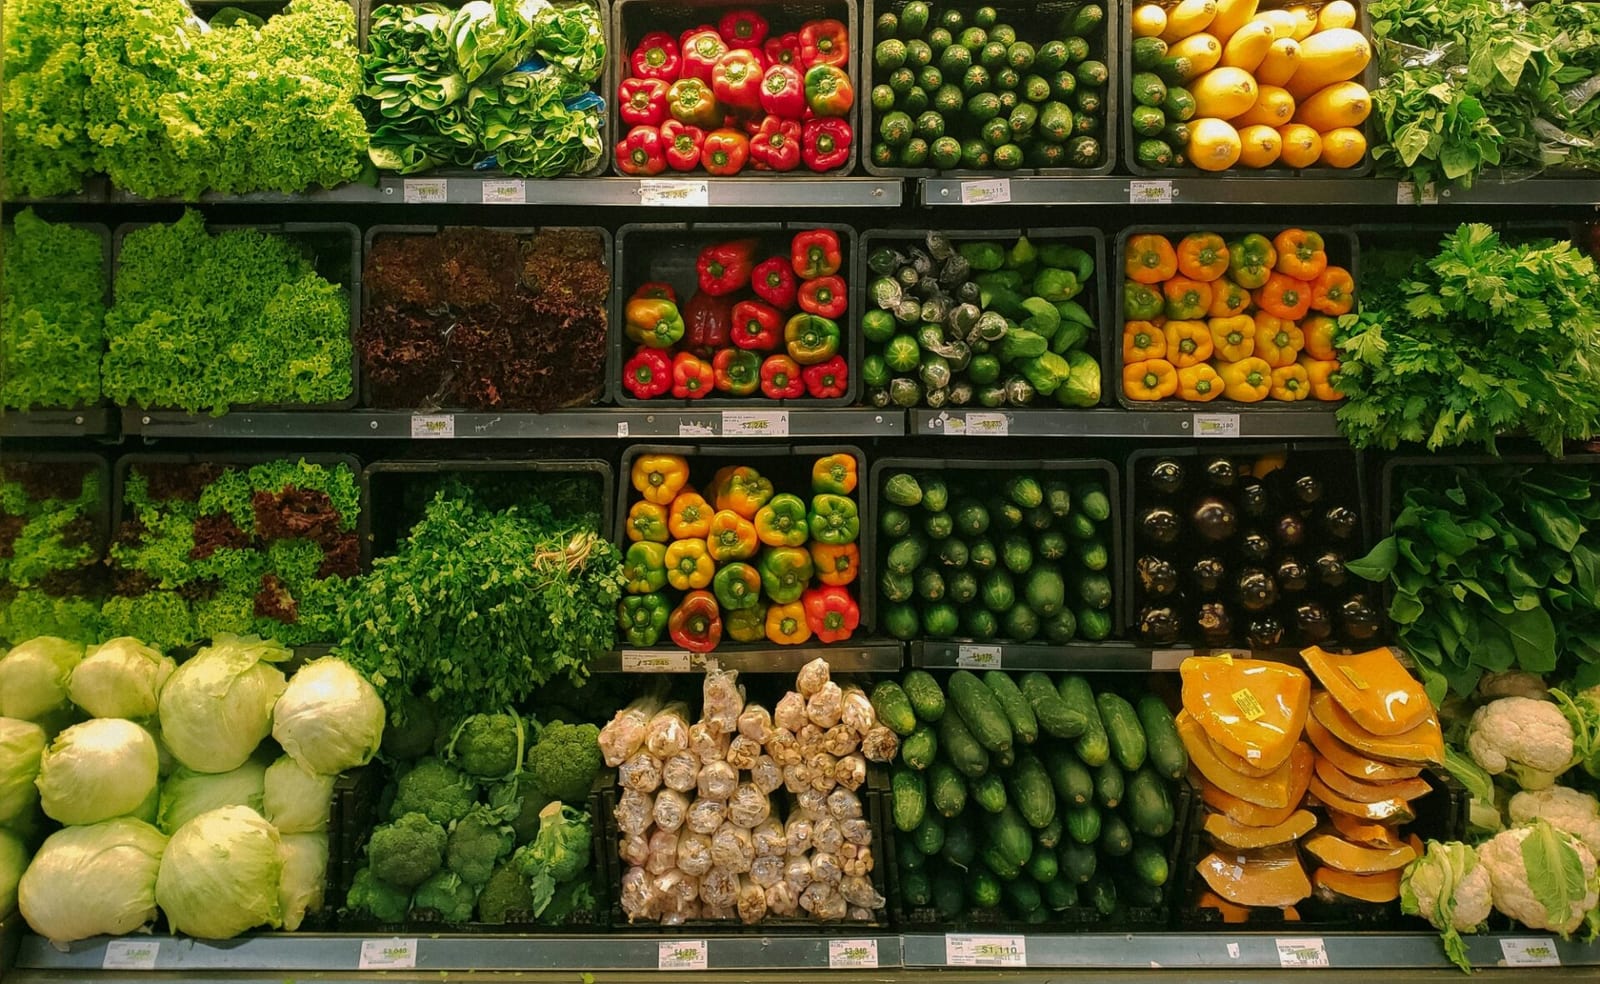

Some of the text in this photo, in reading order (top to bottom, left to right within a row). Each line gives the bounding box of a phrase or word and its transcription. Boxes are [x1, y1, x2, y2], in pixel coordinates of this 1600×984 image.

[700, 185, 707, 193] A
[741, 420, 769, 430] $2,245
[981, 945, 1018, 954] $1,110
